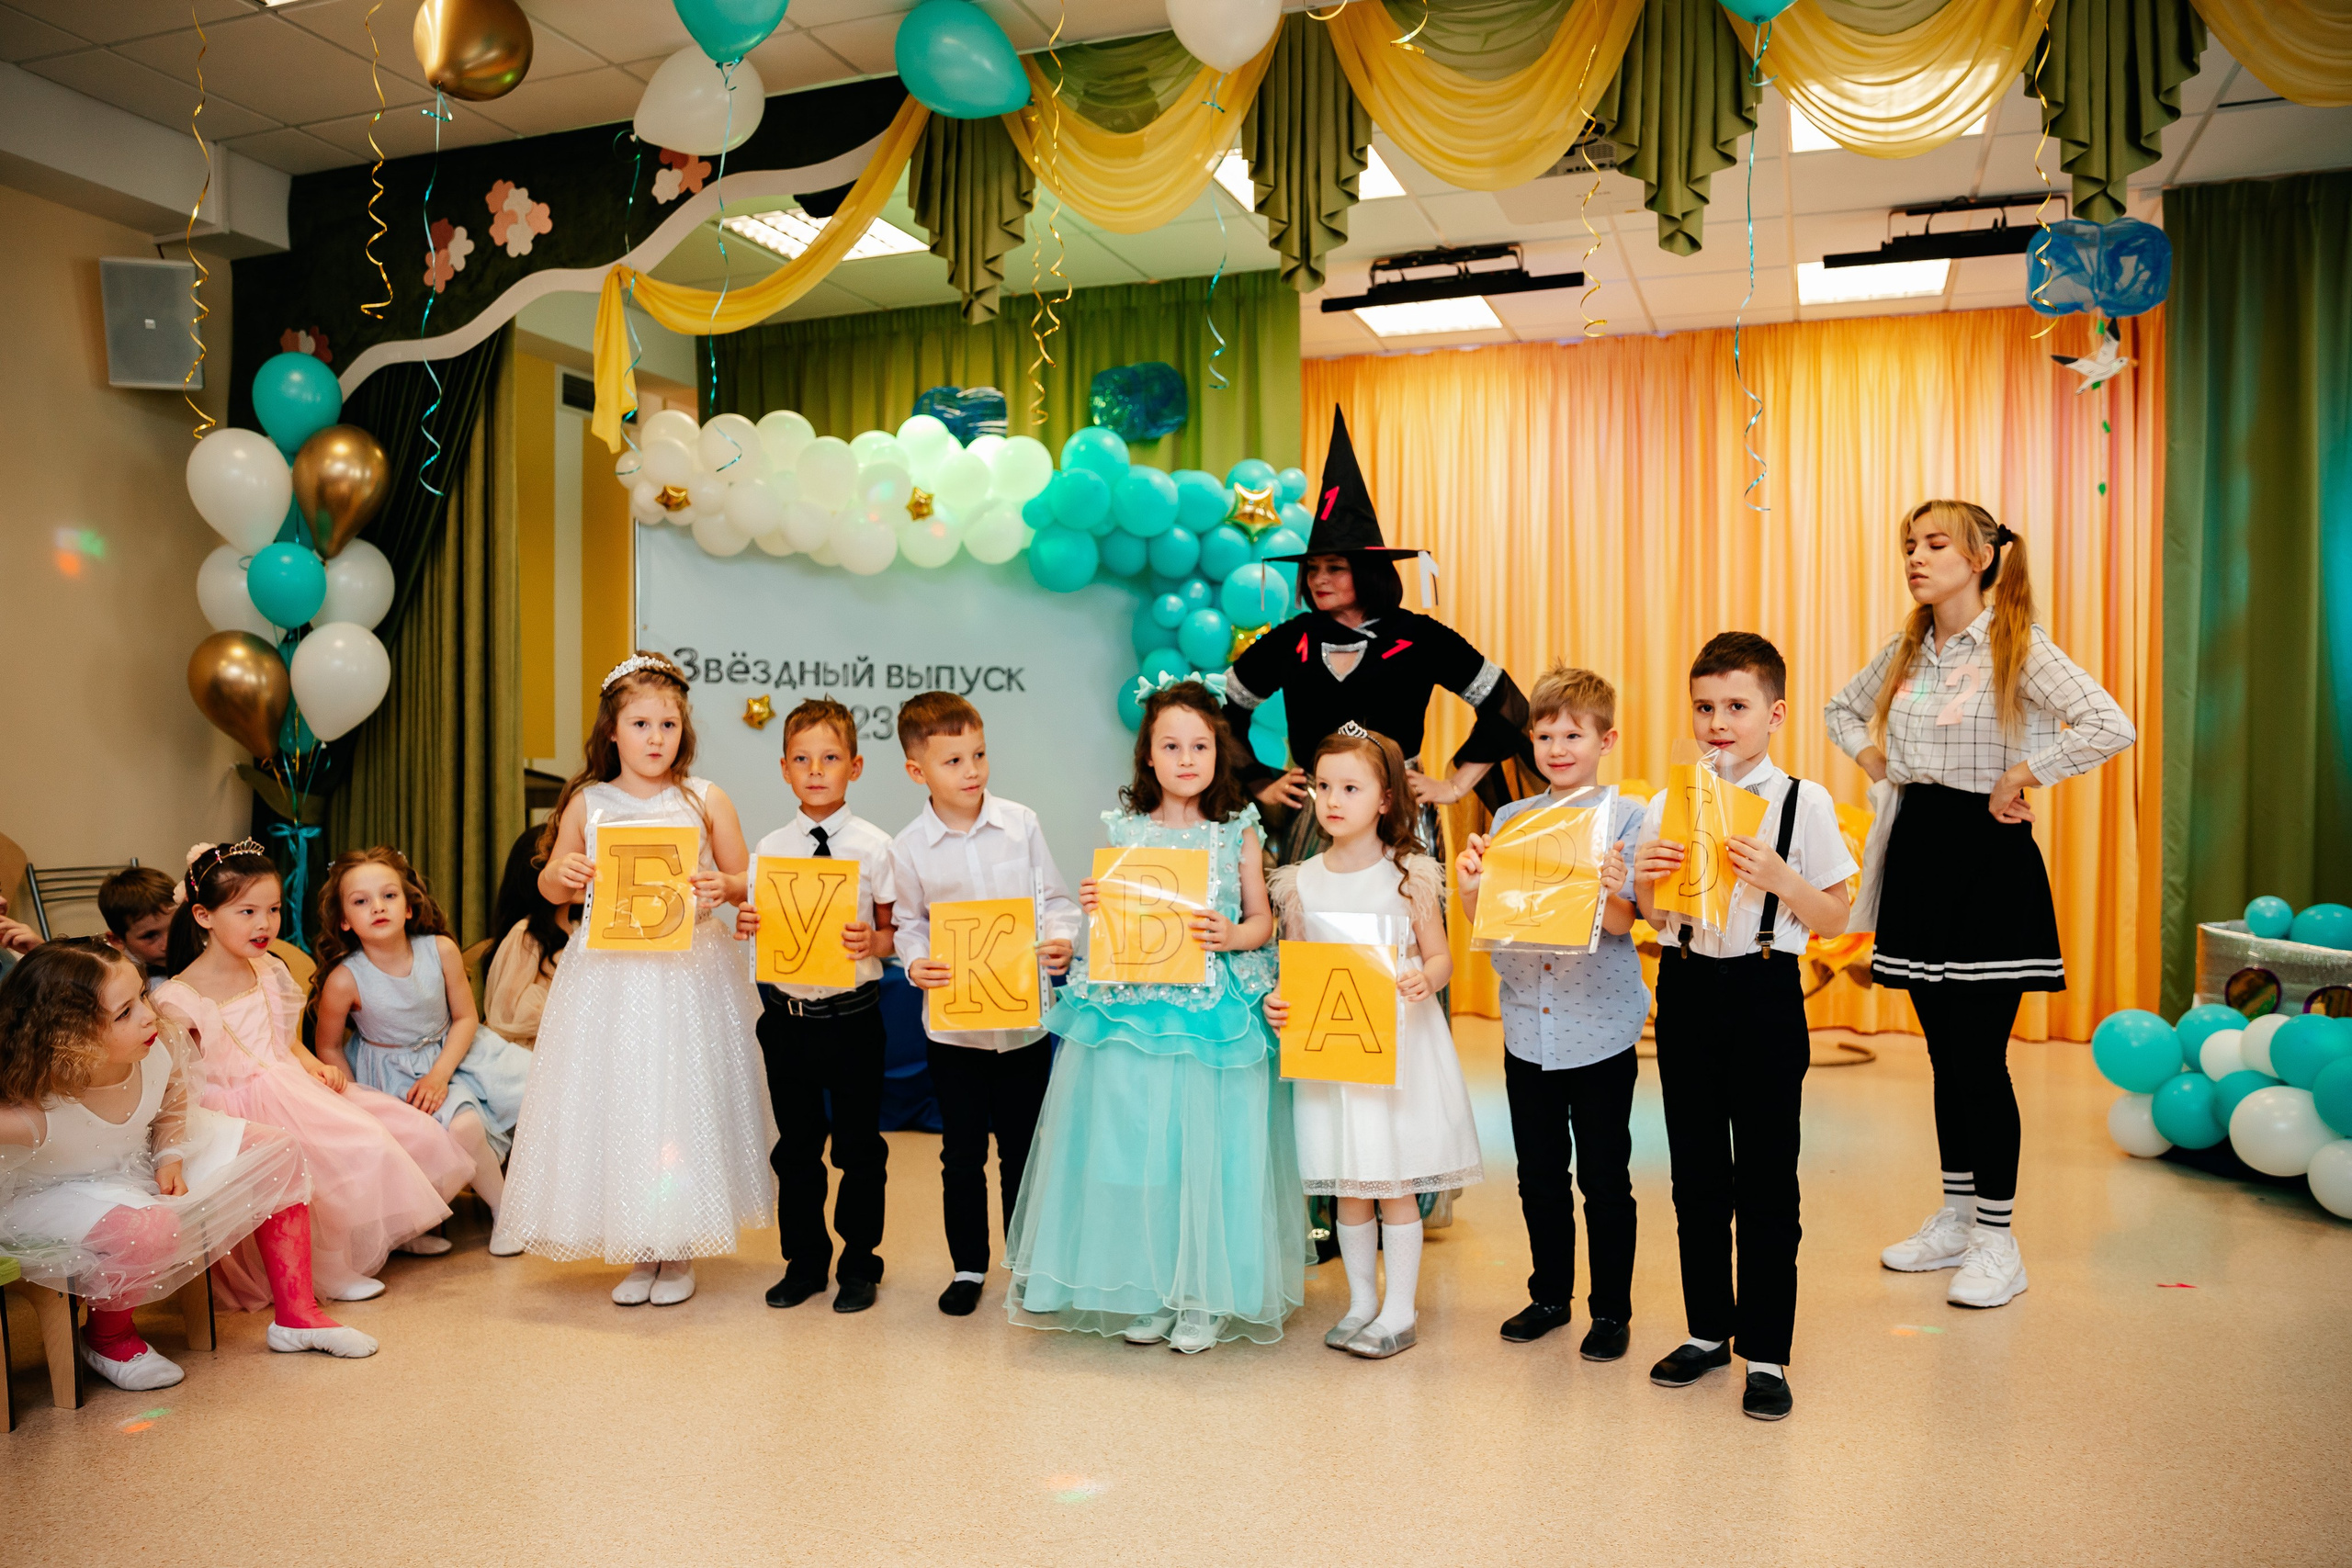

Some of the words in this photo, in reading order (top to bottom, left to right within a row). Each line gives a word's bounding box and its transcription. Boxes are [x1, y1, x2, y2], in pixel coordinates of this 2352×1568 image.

[673, 647, 875, 691] Звёздный
[887, 663, 1026, 695] выпуск
[1936, 664, 1981, 727] 2
[850, 704, 895, 741] 23
[602, 843, 686, 941] Б
[766, 871, 848, 975] У
[1109, 863, 1185, 965] В
[1503, 827, 1577, 928] Р
[944, 913, 1029, 1014] К
[1305, 967, 1383, 1055] А
